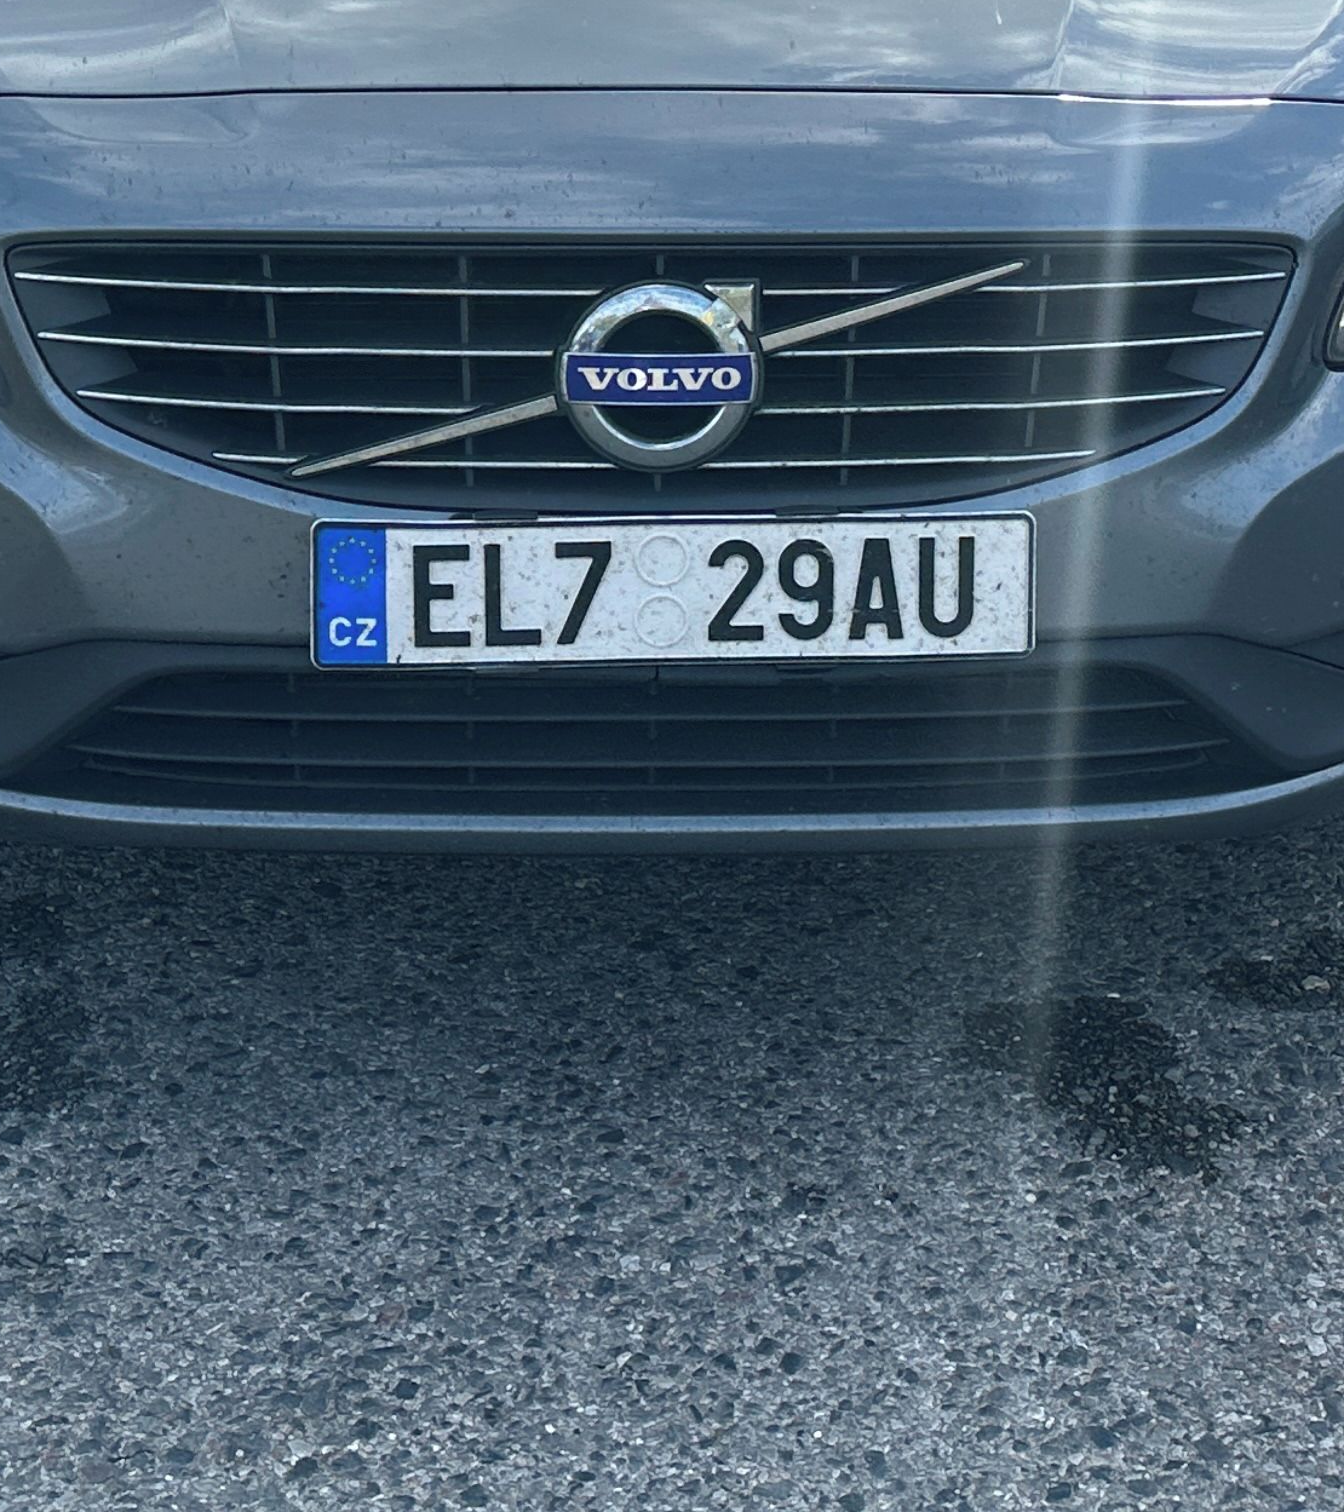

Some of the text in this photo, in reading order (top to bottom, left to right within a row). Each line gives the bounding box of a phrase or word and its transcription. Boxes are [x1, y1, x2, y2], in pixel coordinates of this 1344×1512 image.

[577, 366, 742, 391] VOLVO
[412, 536, 975, 648] EL7 29AU
[328, 616, 377, 647] CZ
